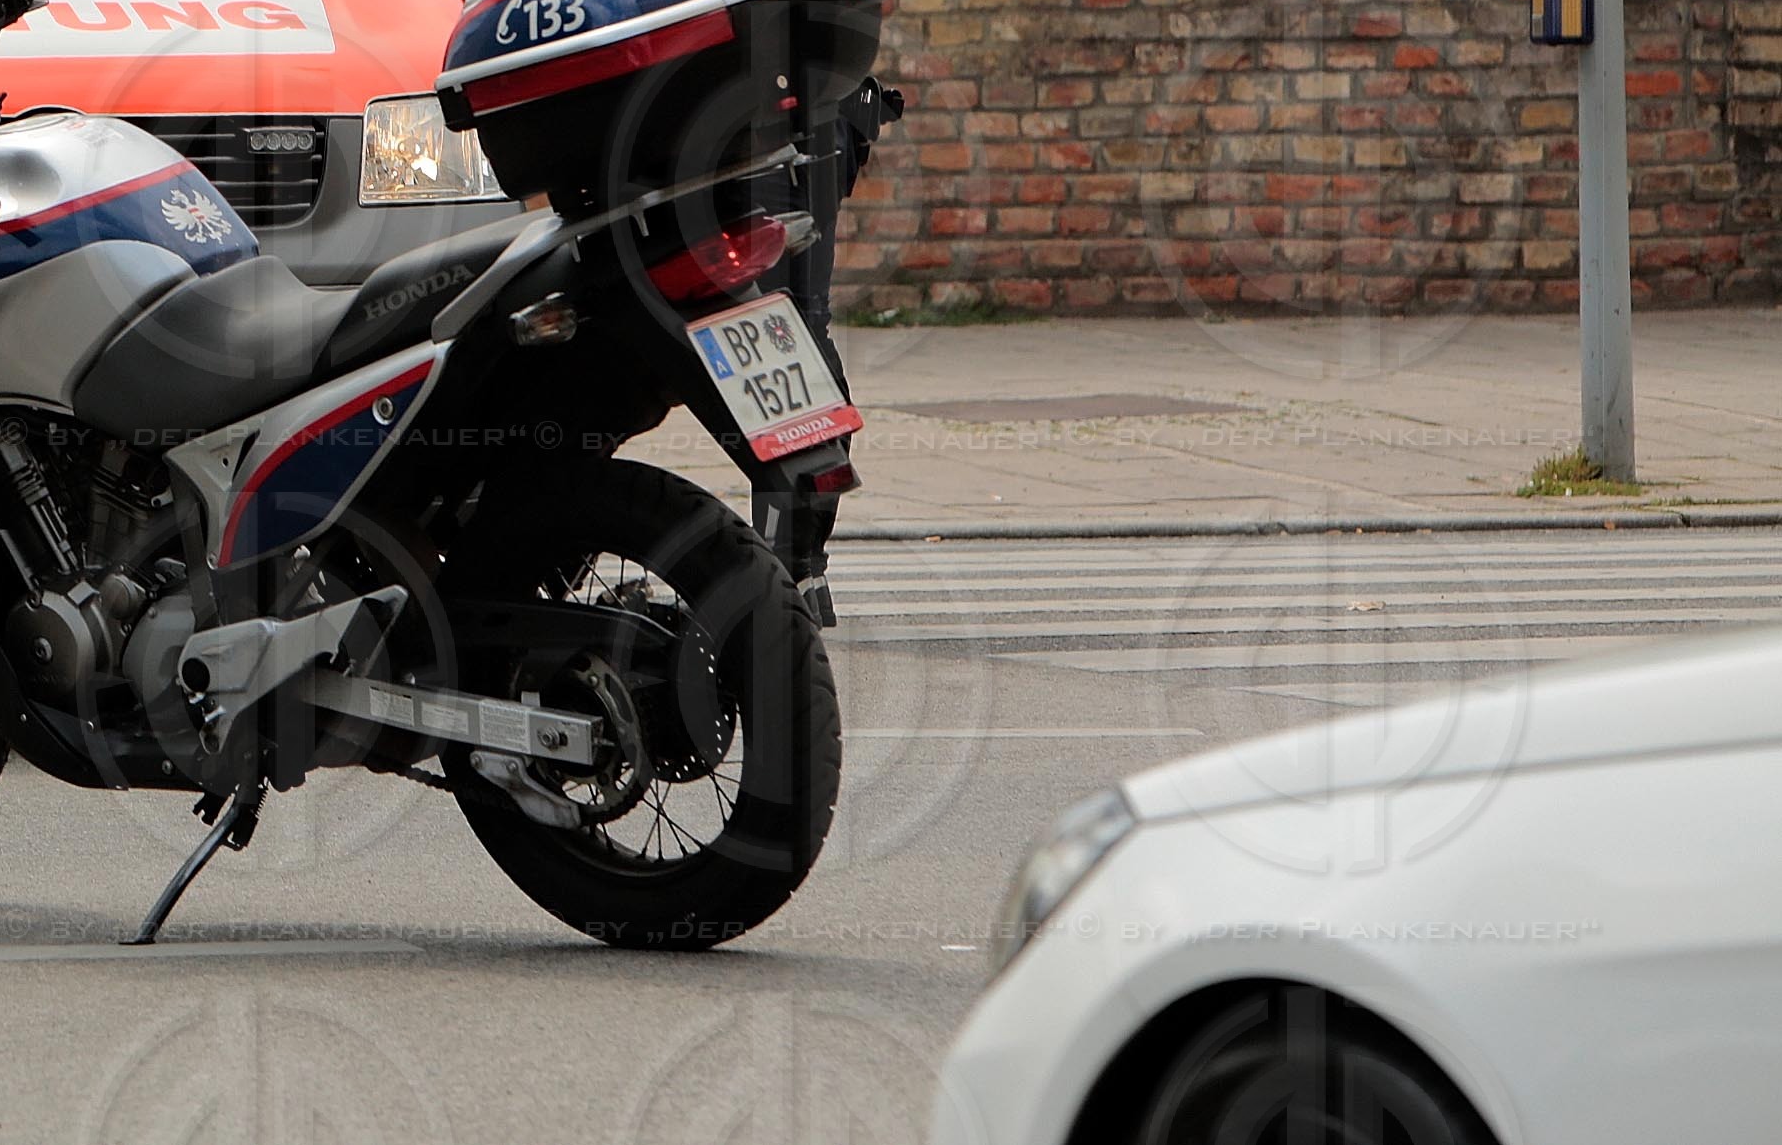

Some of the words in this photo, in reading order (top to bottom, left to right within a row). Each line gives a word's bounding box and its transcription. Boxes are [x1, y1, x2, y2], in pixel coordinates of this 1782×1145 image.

[363, 263, 475, 322] HONDA
[722, 319, 763, 367] BP
[743, 361, 813, 421] 1527
[776, 415, 836, 443] HONDA
